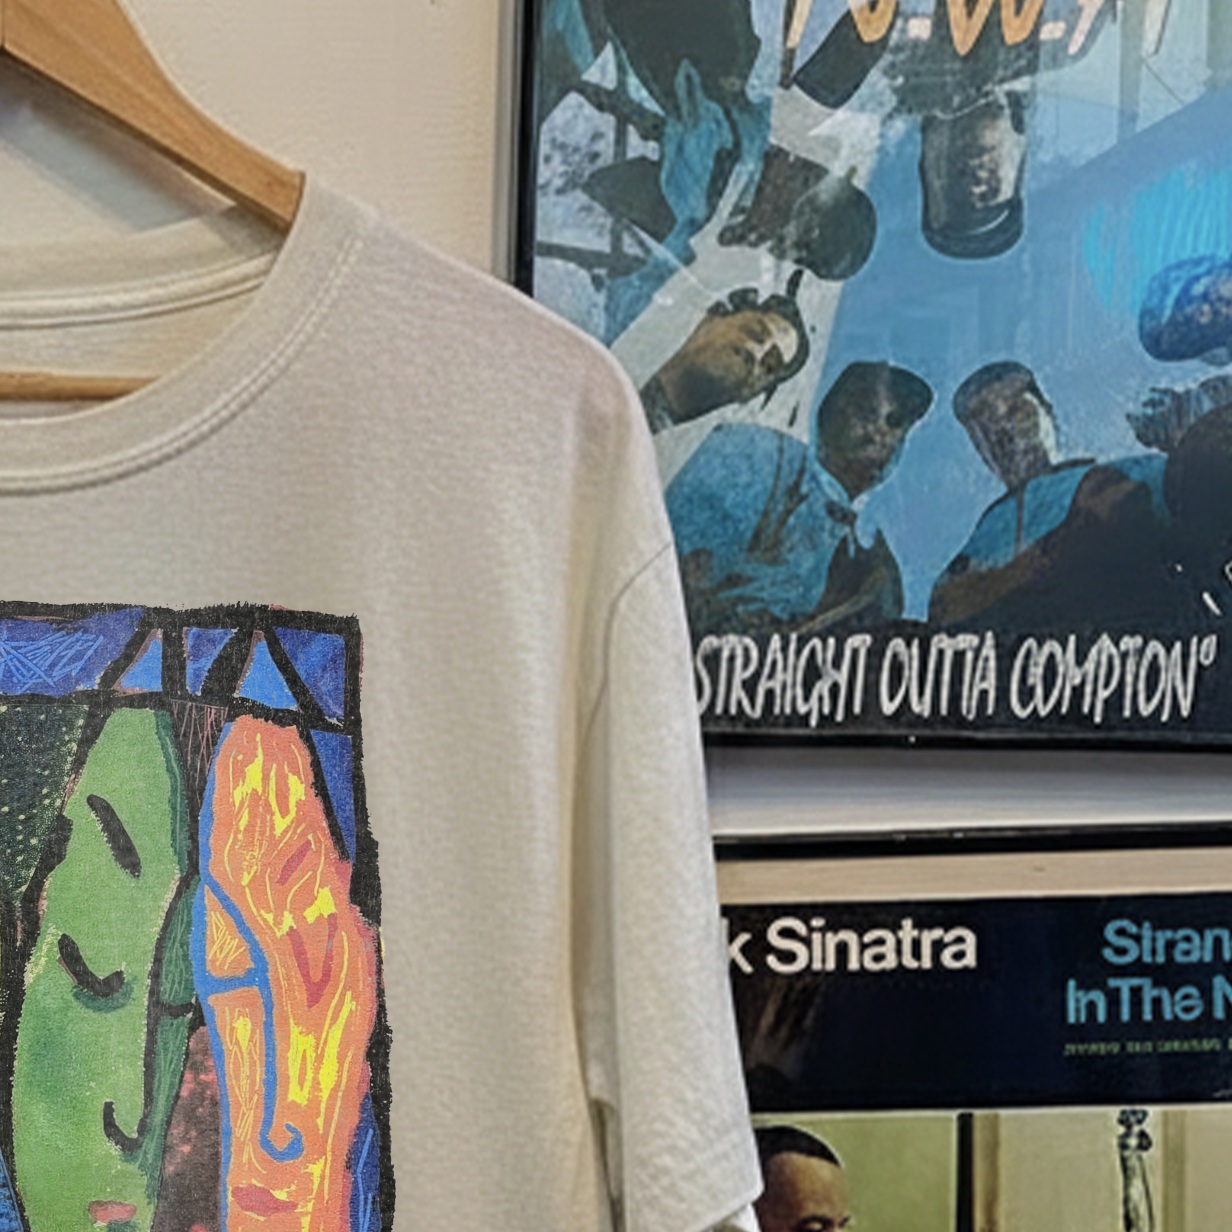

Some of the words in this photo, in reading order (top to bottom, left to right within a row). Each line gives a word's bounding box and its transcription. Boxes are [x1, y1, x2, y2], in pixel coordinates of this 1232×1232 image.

[696, 633, 872, 728] STRAIGHT
[880, 630, 997, 720] OUTTA
[766, 916, 977, 975] Sinatra
